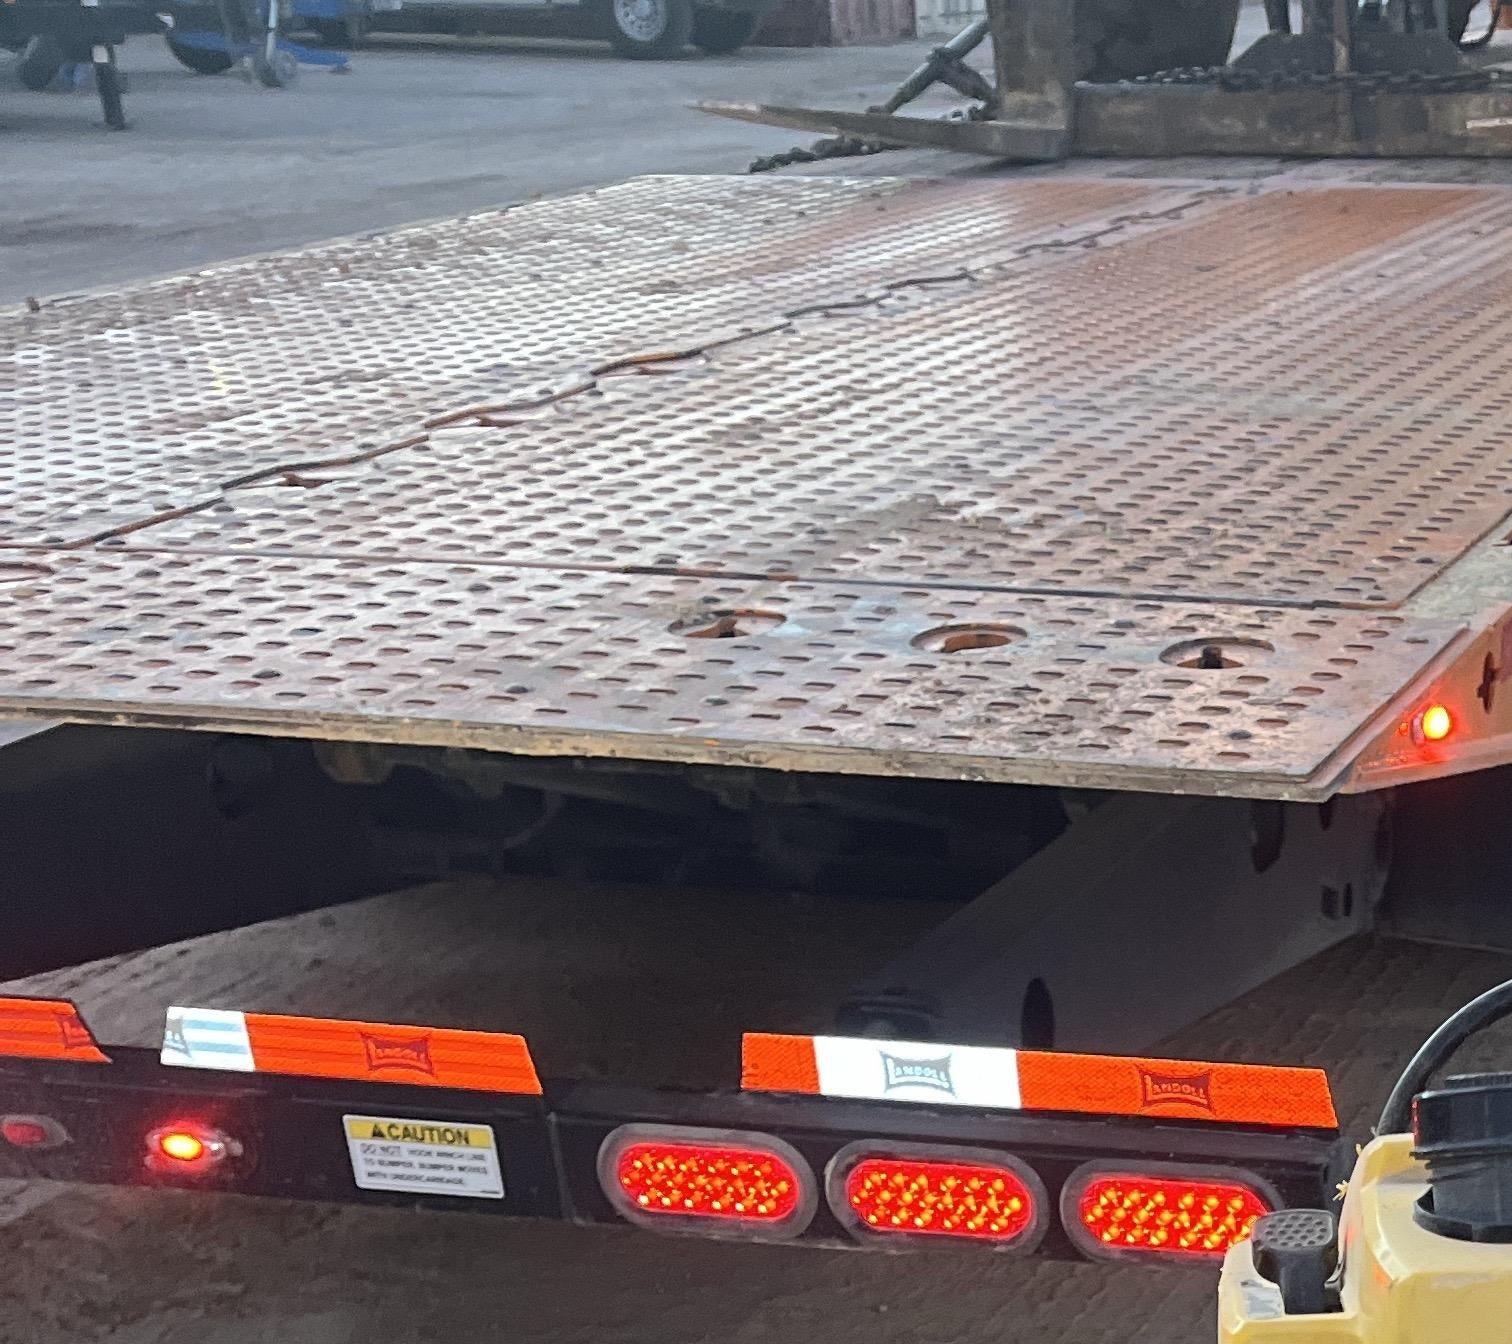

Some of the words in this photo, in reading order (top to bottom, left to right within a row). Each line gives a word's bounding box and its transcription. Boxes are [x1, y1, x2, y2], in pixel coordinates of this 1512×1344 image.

[886, 1057, 950, 1089] LANDOLL
[1143, 1074, 1209, 1105] LANDOLL
[387, 1123, 470, 1145] CAUTION
